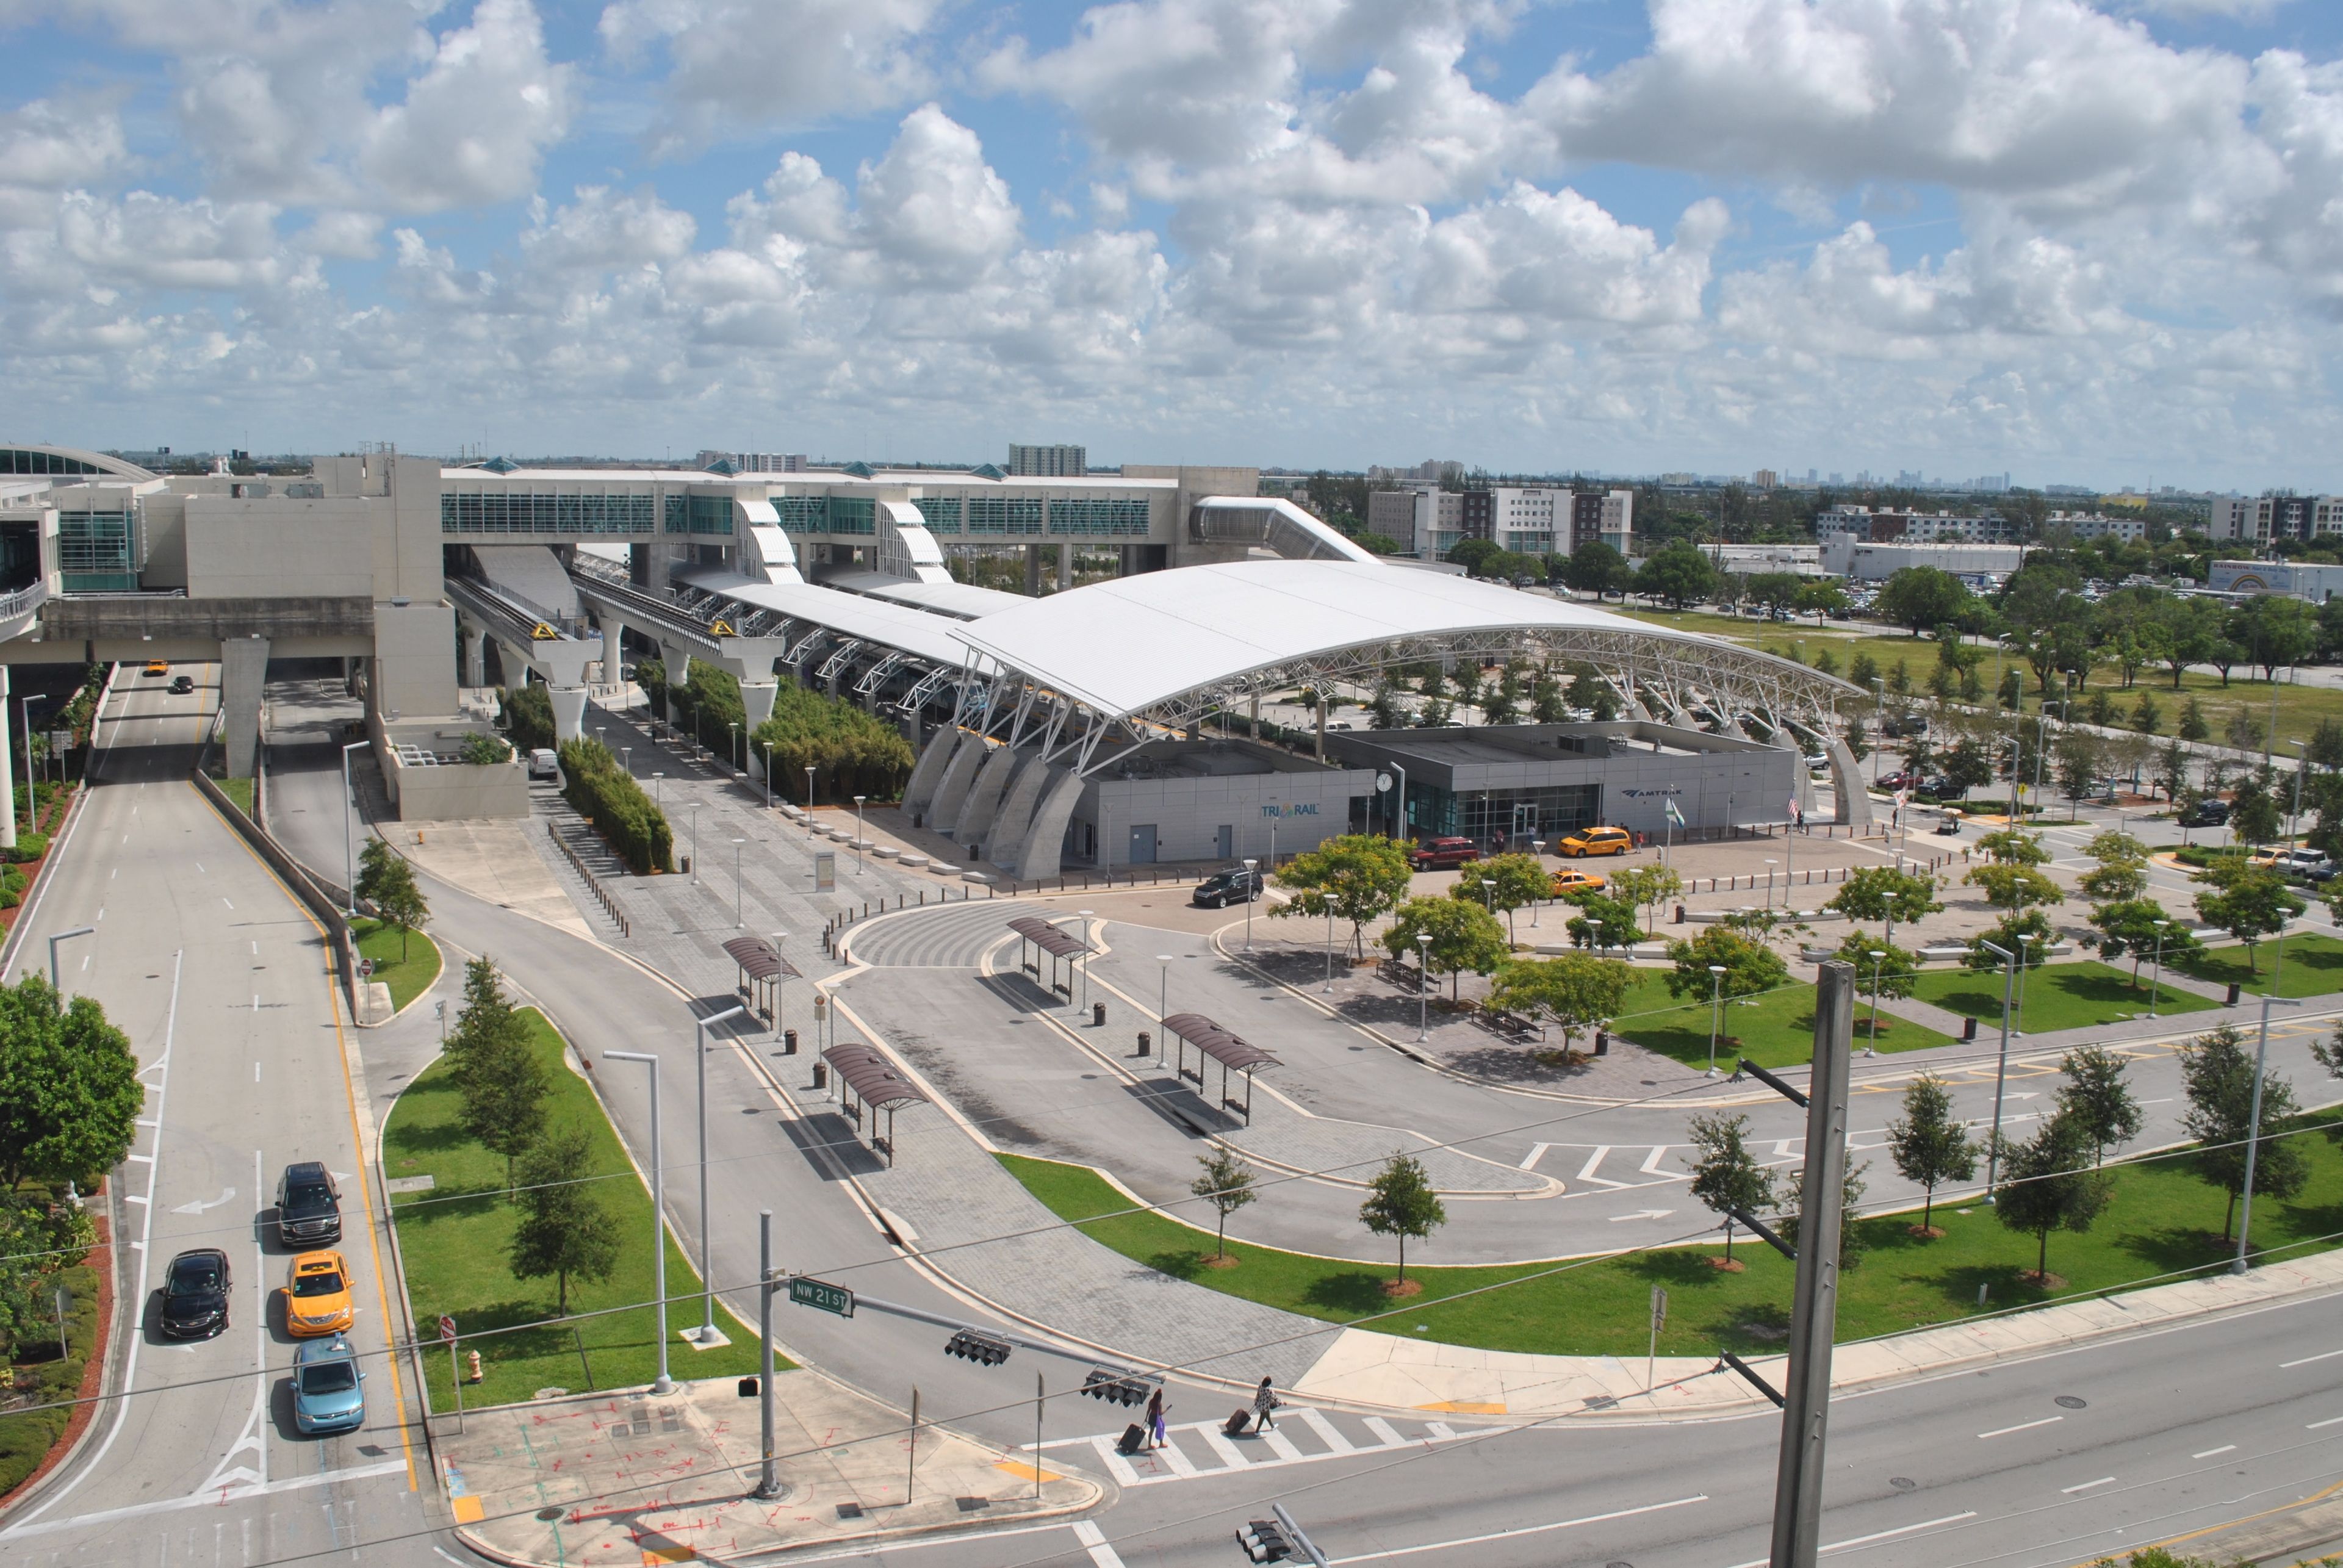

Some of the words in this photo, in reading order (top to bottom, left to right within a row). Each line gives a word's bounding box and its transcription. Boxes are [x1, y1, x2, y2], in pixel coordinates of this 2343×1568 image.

[1262, 806, 1279, 817] TRI
[1294, 804, 1319, 815] RAIL
[797, 1283, 812, 1298] NW
[816, 1289, 829, 1304] 21
[833, 1294, 846, 1307] ST
